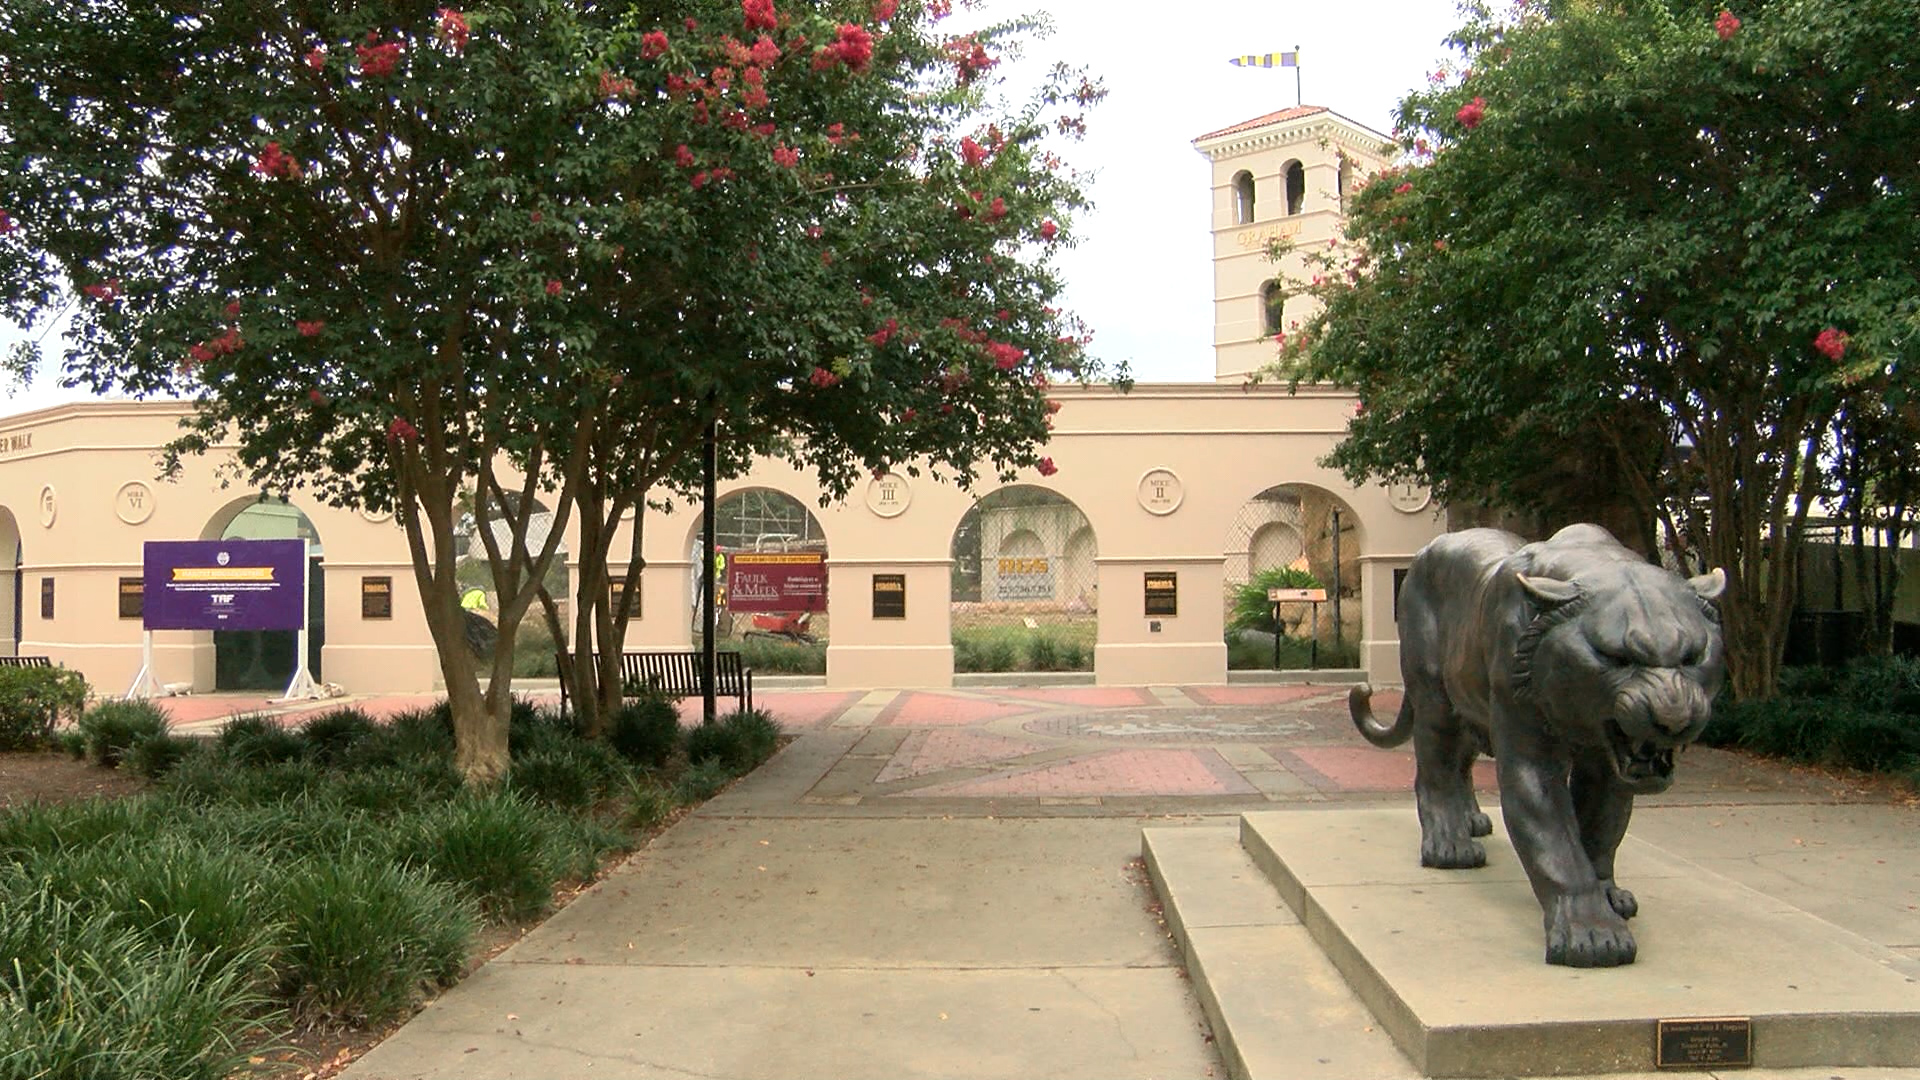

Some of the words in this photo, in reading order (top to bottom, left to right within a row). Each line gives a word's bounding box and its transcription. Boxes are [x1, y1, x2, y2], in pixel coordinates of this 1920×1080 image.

[10, 432, 32, 450] WALK
[882, 490, 895, 500] III
[1156, 487, 1164, 498] II
[130, 498, 142, 508] VI
[732, 584, 744, 595] &
[211, 594, 235, 603] TAF
